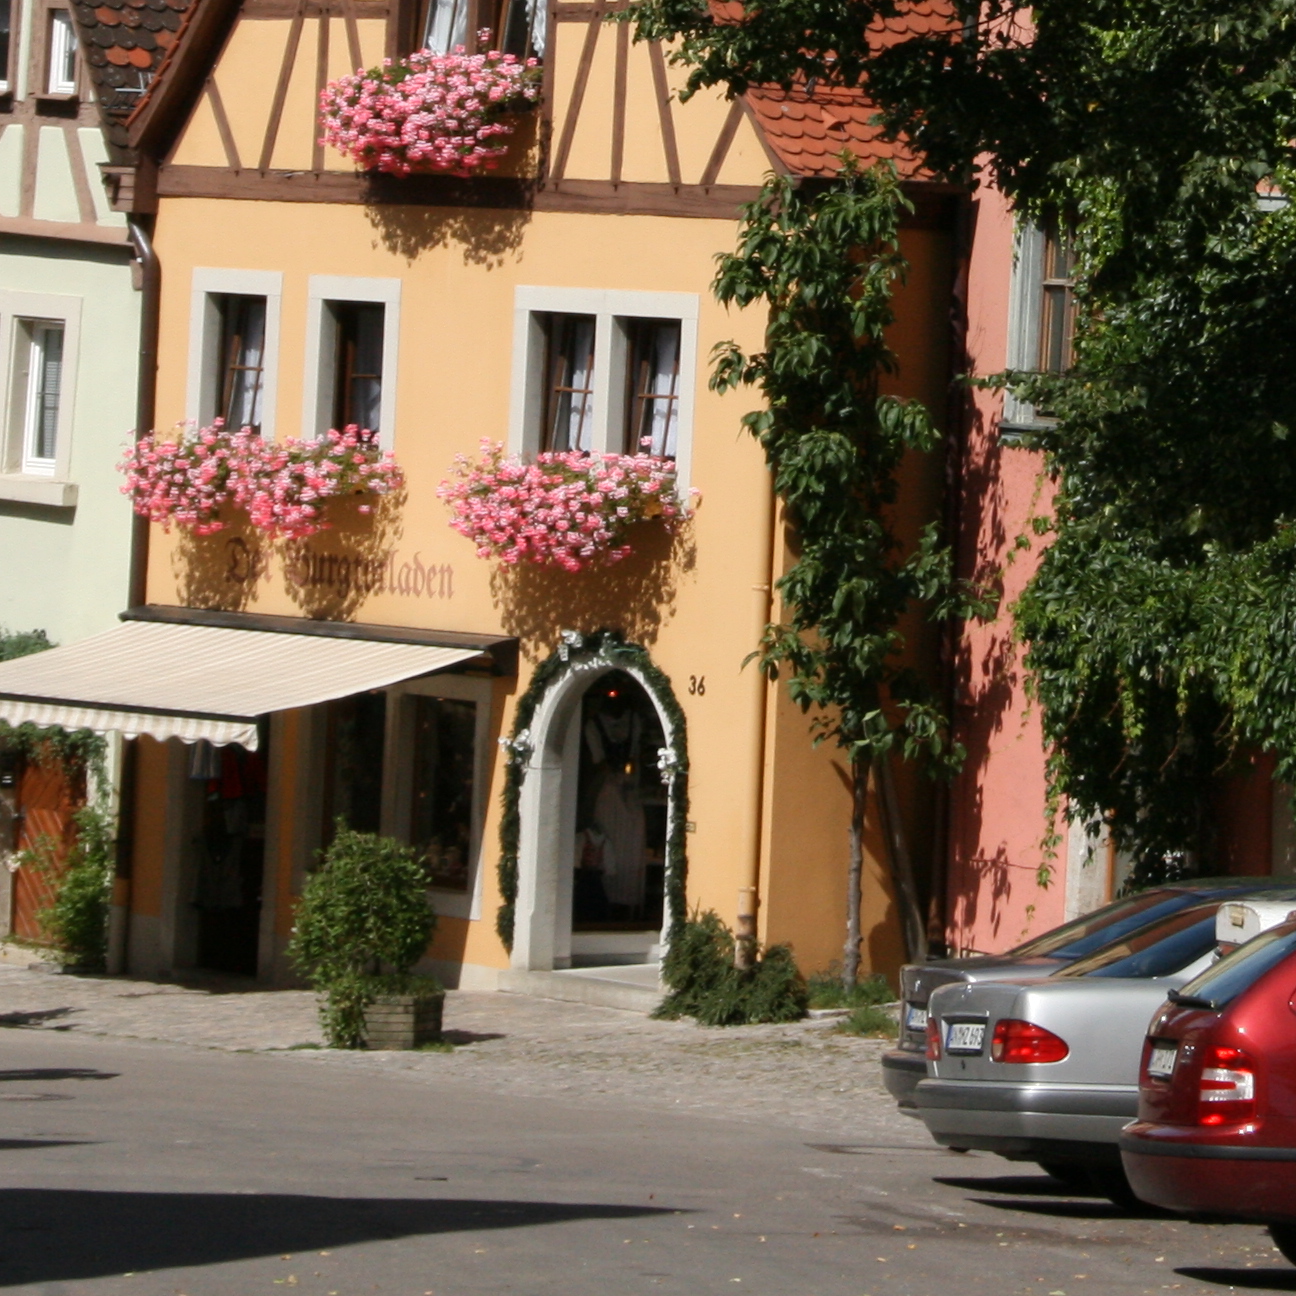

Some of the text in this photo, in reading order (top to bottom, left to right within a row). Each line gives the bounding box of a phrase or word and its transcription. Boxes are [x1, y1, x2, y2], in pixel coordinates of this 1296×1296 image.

[225, 537, 455, 600] Der Burgtorladen
[688, 674, 706, 697] 36
